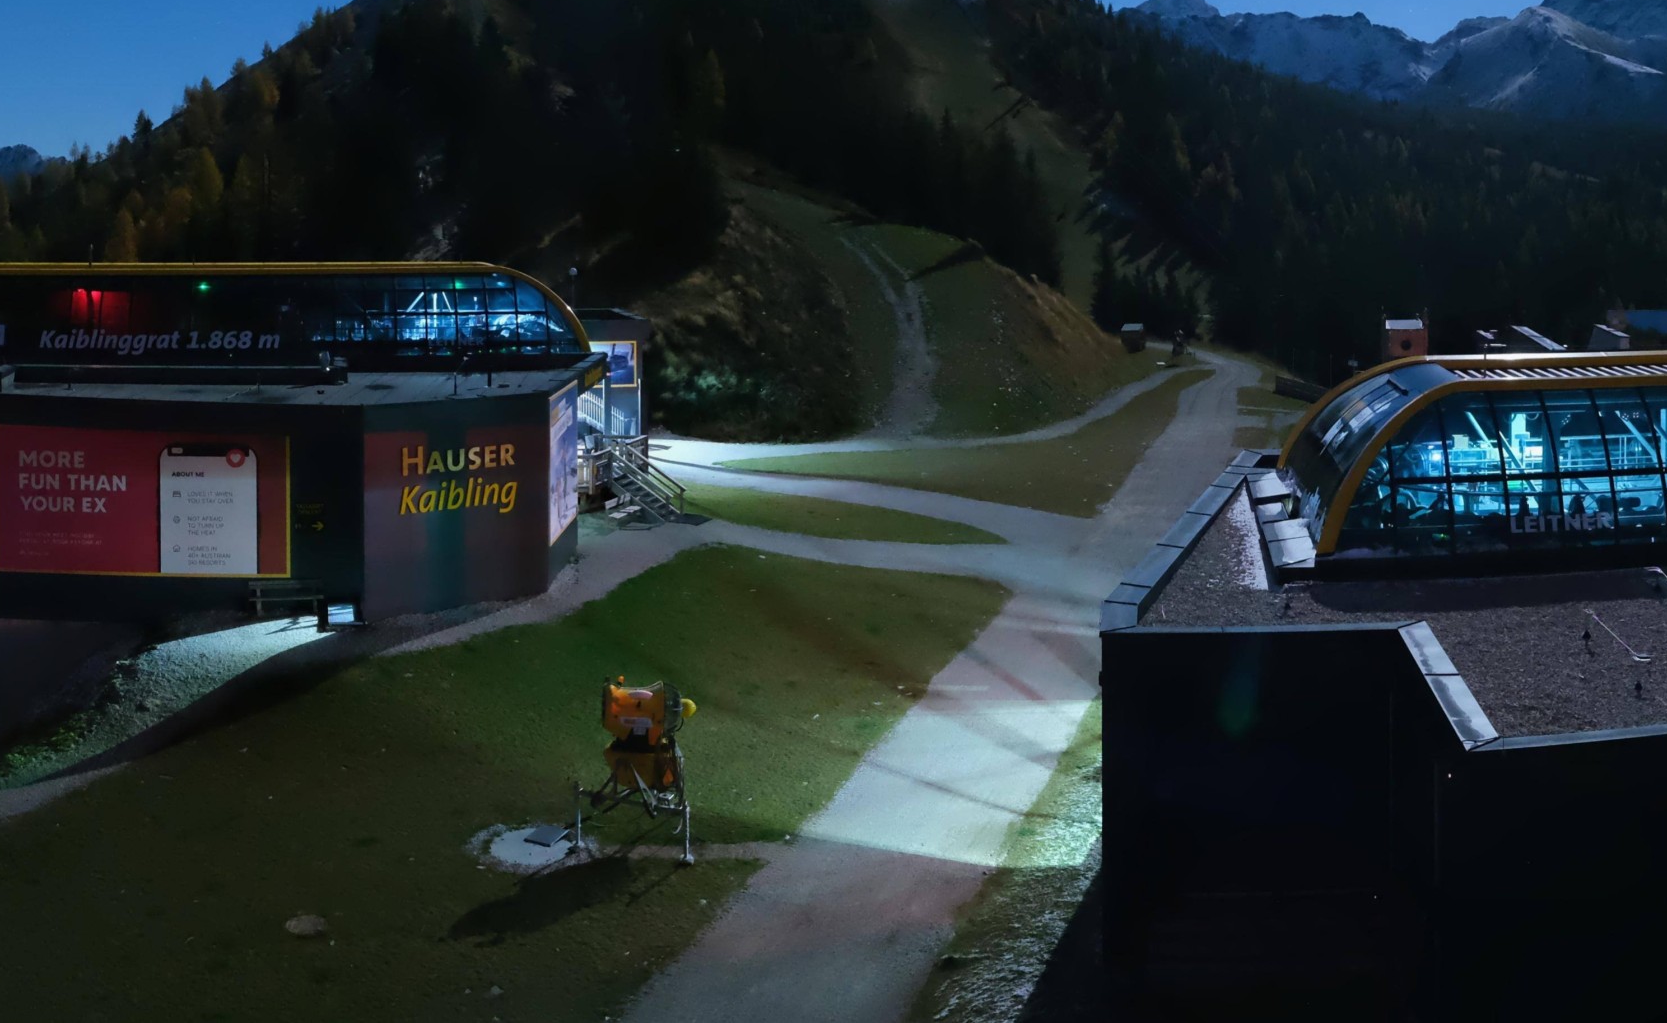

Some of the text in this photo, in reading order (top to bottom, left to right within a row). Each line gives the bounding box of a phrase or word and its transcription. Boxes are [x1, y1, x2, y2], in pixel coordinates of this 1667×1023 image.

[39, 324, 280, 355] Kaiblinggrat 1.868 m
[19, 450, 85, 468] MORE
[402, 444, 515, 476] HAUSER
[19, 473, 127, 492] FUN THAN
[20, 496, 107, 513] YOUR EX
[400, 477, 518, 515] Kaibling
[1510, 511, 1614, 534] LEITNER
